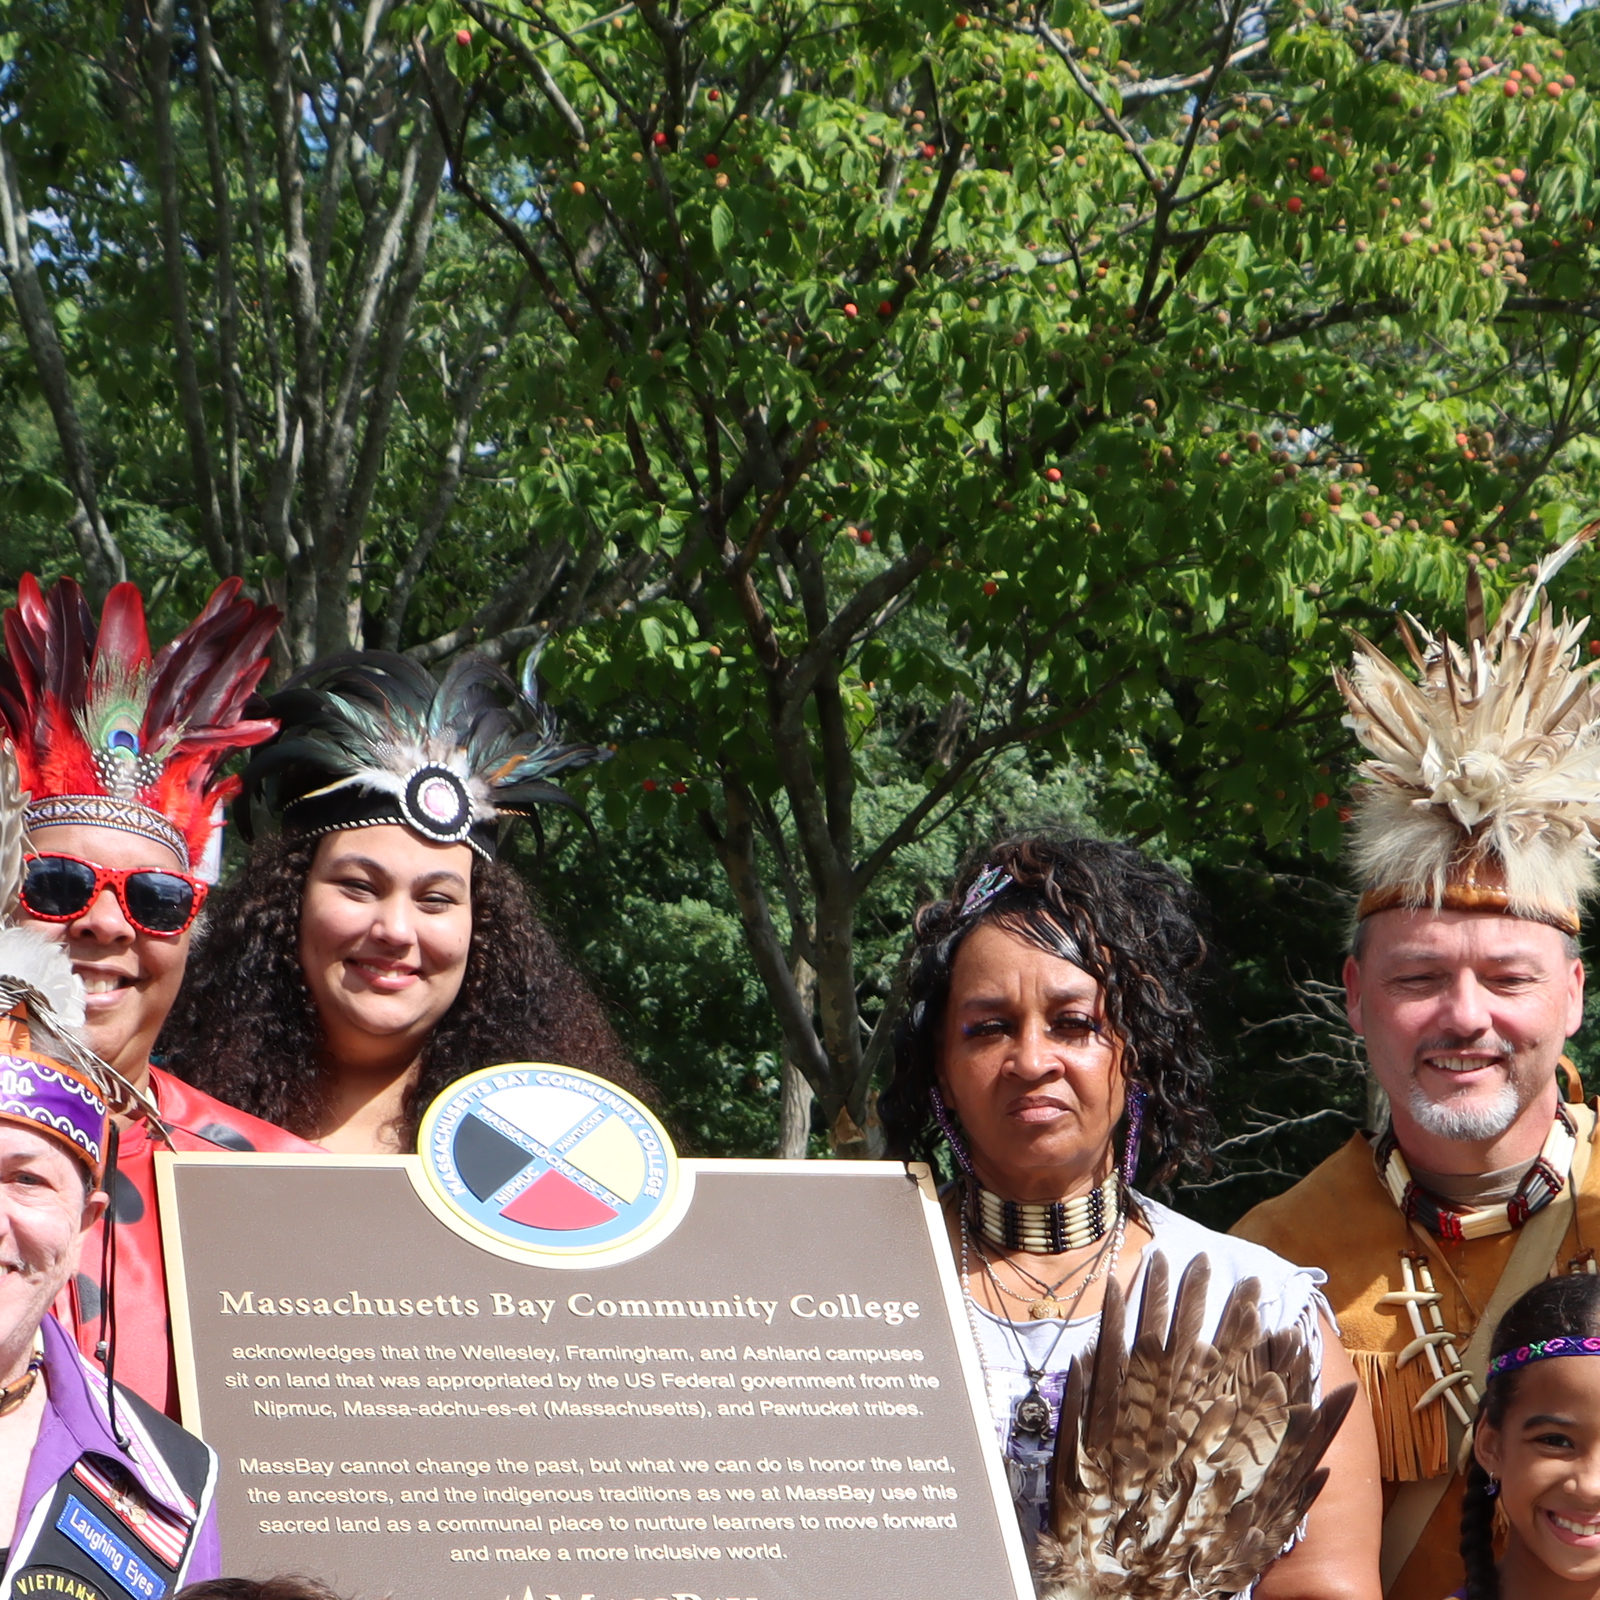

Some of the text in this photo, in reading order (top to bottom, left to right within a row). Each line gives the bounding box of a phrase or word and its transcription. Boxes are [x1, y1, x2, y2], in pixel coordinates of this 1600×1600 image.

[433, 1072, 664, 1199] MASSACHUSETTS BAY COMMUNITY COLLEGE
[555, 1109, 607, 1153] PAWTUCKET
[476, 1107, 624, 1208] MASSA-ADCHU-ES-ET
[494, 1166, 540, 1206] NIPMUC
[219, 1290, 921, 1326] Massachusetts Bay Community College
[232, 1343, 925, 1365] acknowledges that the Wellesley, Framingham, and Ashland campuses
[225, 1372, 940, 1392] sit on land that was appropriated by the US Federal government from the
[253, 1400, 924, 1420] Nipmuc, Massa-adchu-es-et (Massachusetts), and Pawtucket tribes.
[239, 1455, 956, 1477] MassBay cannot change the past, but what we can do is honor the land,
[247, 1484, 958, 1506] the ancestors, and the indigenous traditions as we at MassBay use this
[259, 1512, 958, 1535] sacred land as a communal place to nurture learners to move forward
[69, 1508, 154, 1596] Laughing Eyes
[450, 1542, 788, 1562] and make a more inclusive world.
[16, 1574, 87, 1600] VIETNAM
